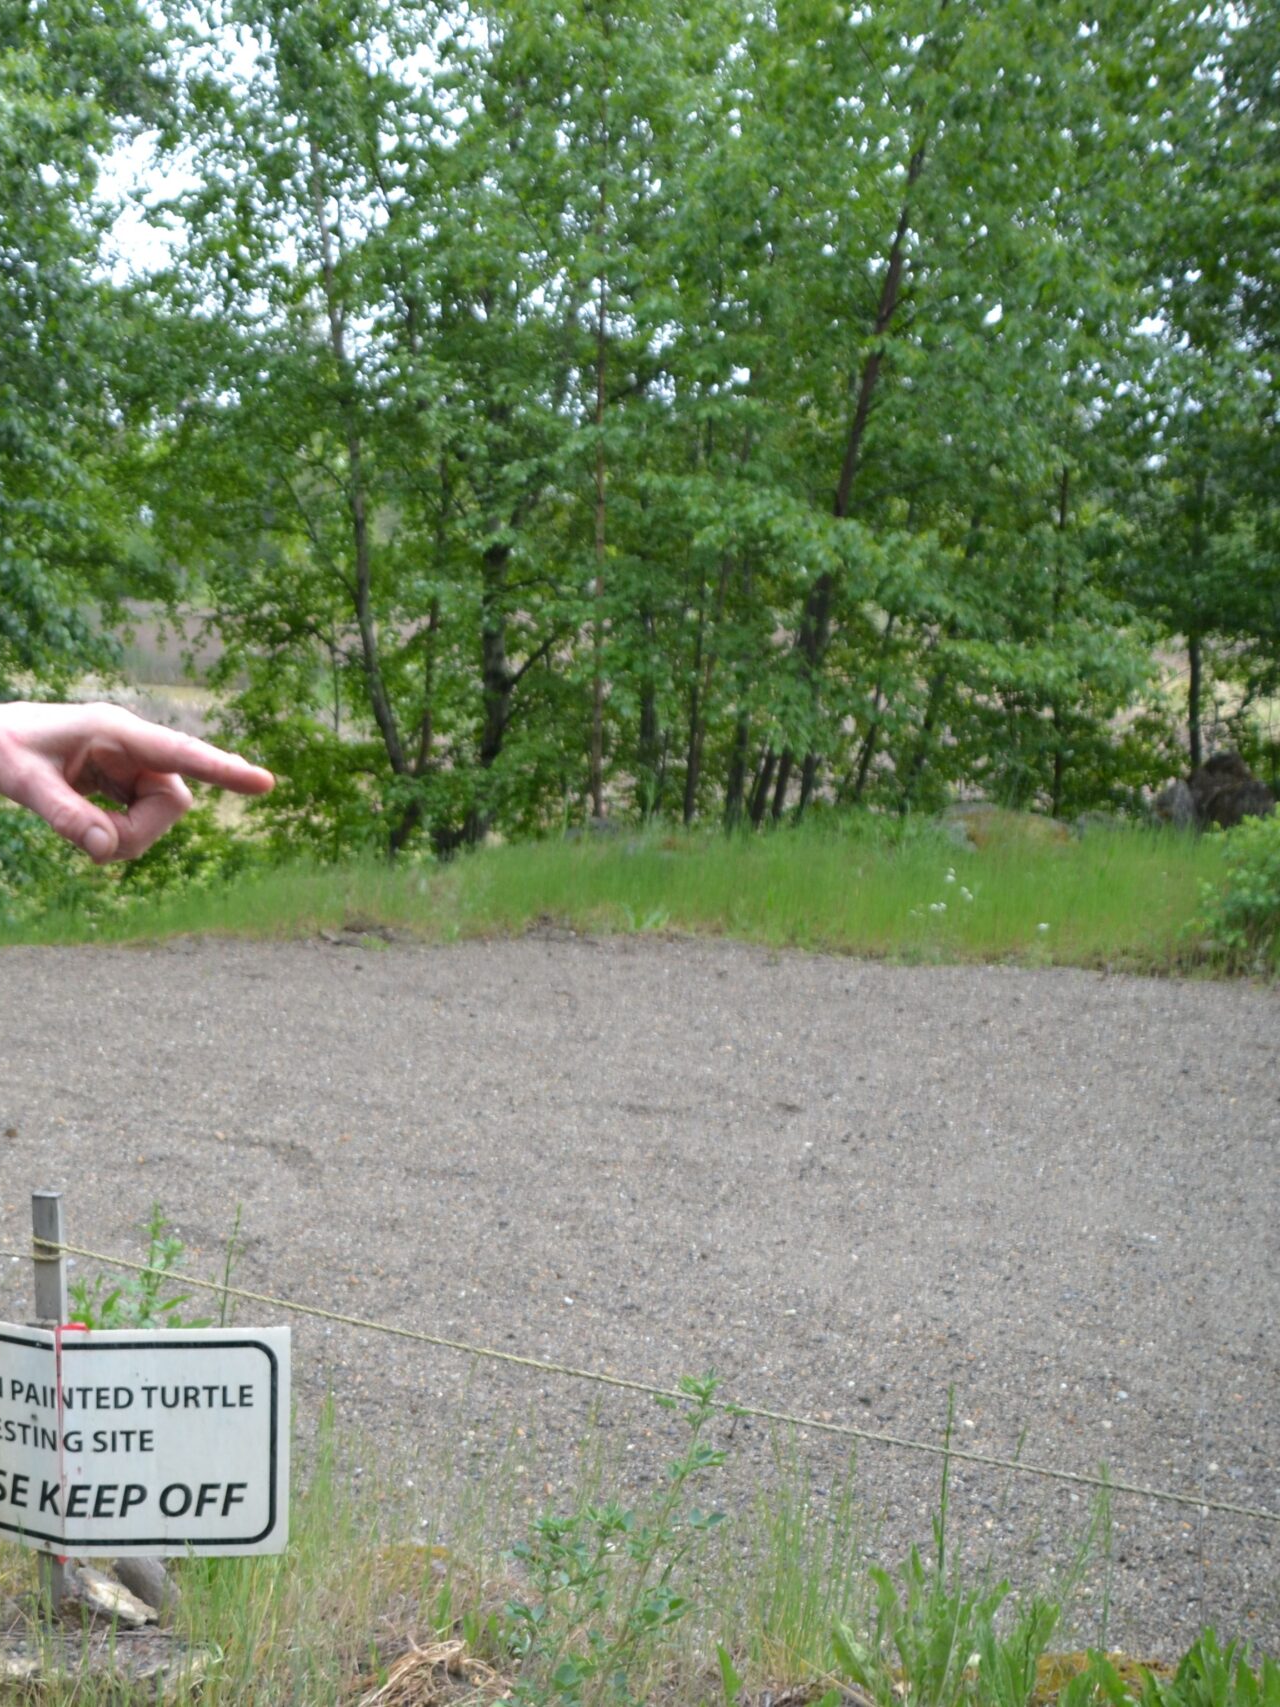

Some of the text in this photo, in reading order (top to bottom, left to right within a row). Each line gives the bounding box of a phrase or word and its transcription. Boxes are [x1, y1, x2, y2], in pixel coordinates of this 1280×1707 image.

[11, 1379, 134, 1410] PAINTED
[141, 1385, 254, 1409] TURTLE
[92, 1430, 154, 1452] SITE
[39, 1481, 147, 1518] KEEP
[159, 1482, 247, 1517] OFF
